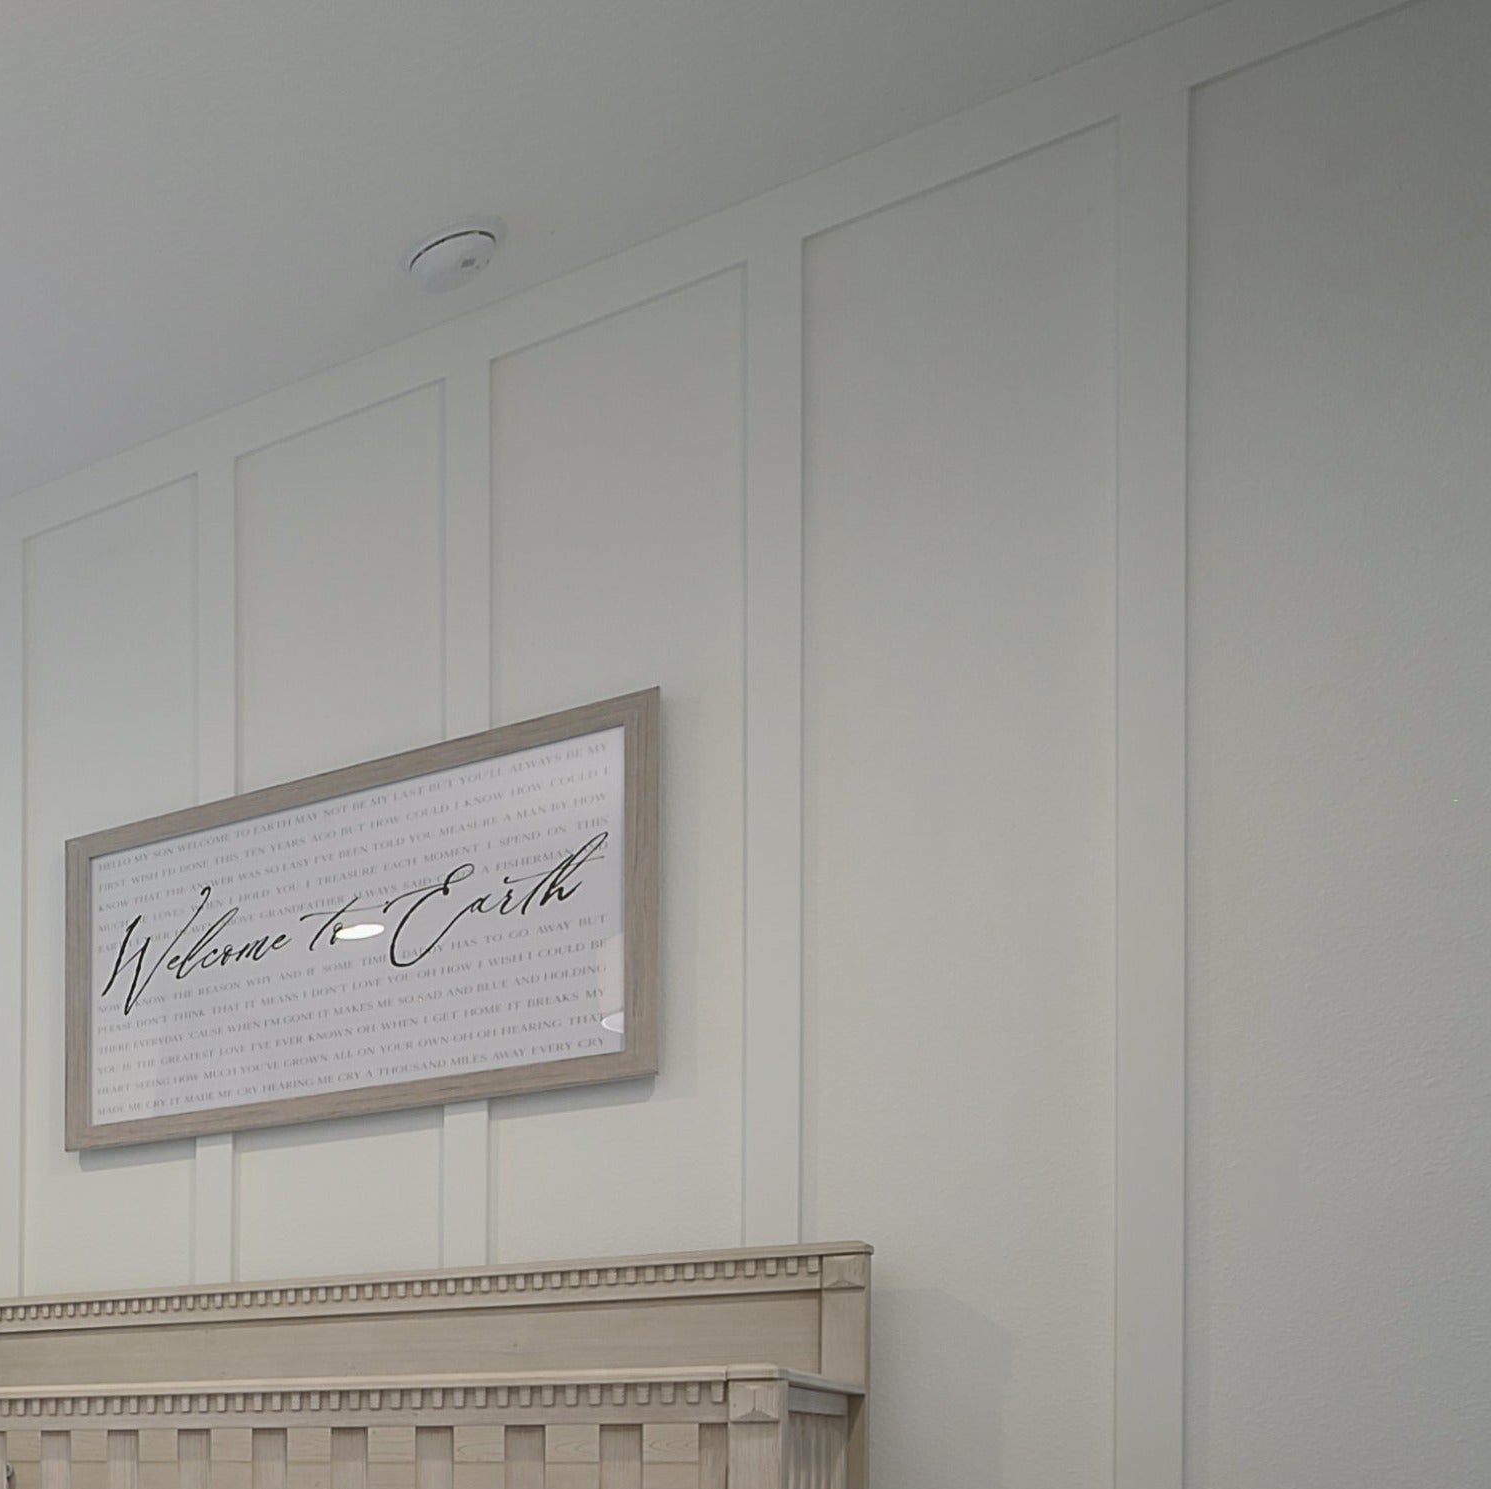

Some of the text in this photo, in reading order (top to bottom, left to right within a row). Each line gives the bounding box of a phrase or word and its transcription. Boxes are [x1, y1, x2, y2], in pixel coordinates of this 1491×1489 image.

[98, 740, 607, 873] HELLO MY SON WELCOME TO EARTH MAY NOT BE MY LAST BUT YOU'LL ALWAYS BE MY
[101, 886, 293, 1016] Welcome
[382, 831, 609, 968] Earth
[98, 1041, 130, 1056] THERE
[132, 1032, 183, 1050] EVERYDAY
[226, 1019, 260, 1035] WHEN
[263, 1016, 280, 1028] I'M
[282, 1010, 315, 1025] GONE
[317, 1008, 328, 1019] IT
[332, 1000, 374, 1017] MAKES
[377, 996, 394, 1009] ME
[398, 993, 414, 1006] SO
[416, 988, 443, 1003] SAD
[445, 983, 474, 998] AND
[475, 977, 508, 993] BLUE
[513, 972, 540, 987] AND
[543, 960, 607, 982] HOLDING
[97, 1034, 604, 1117] MADE ME CRY IT MADE ME CRY HEARING ME CRY A THOUSAND MILES AWAY EVERY CRY
